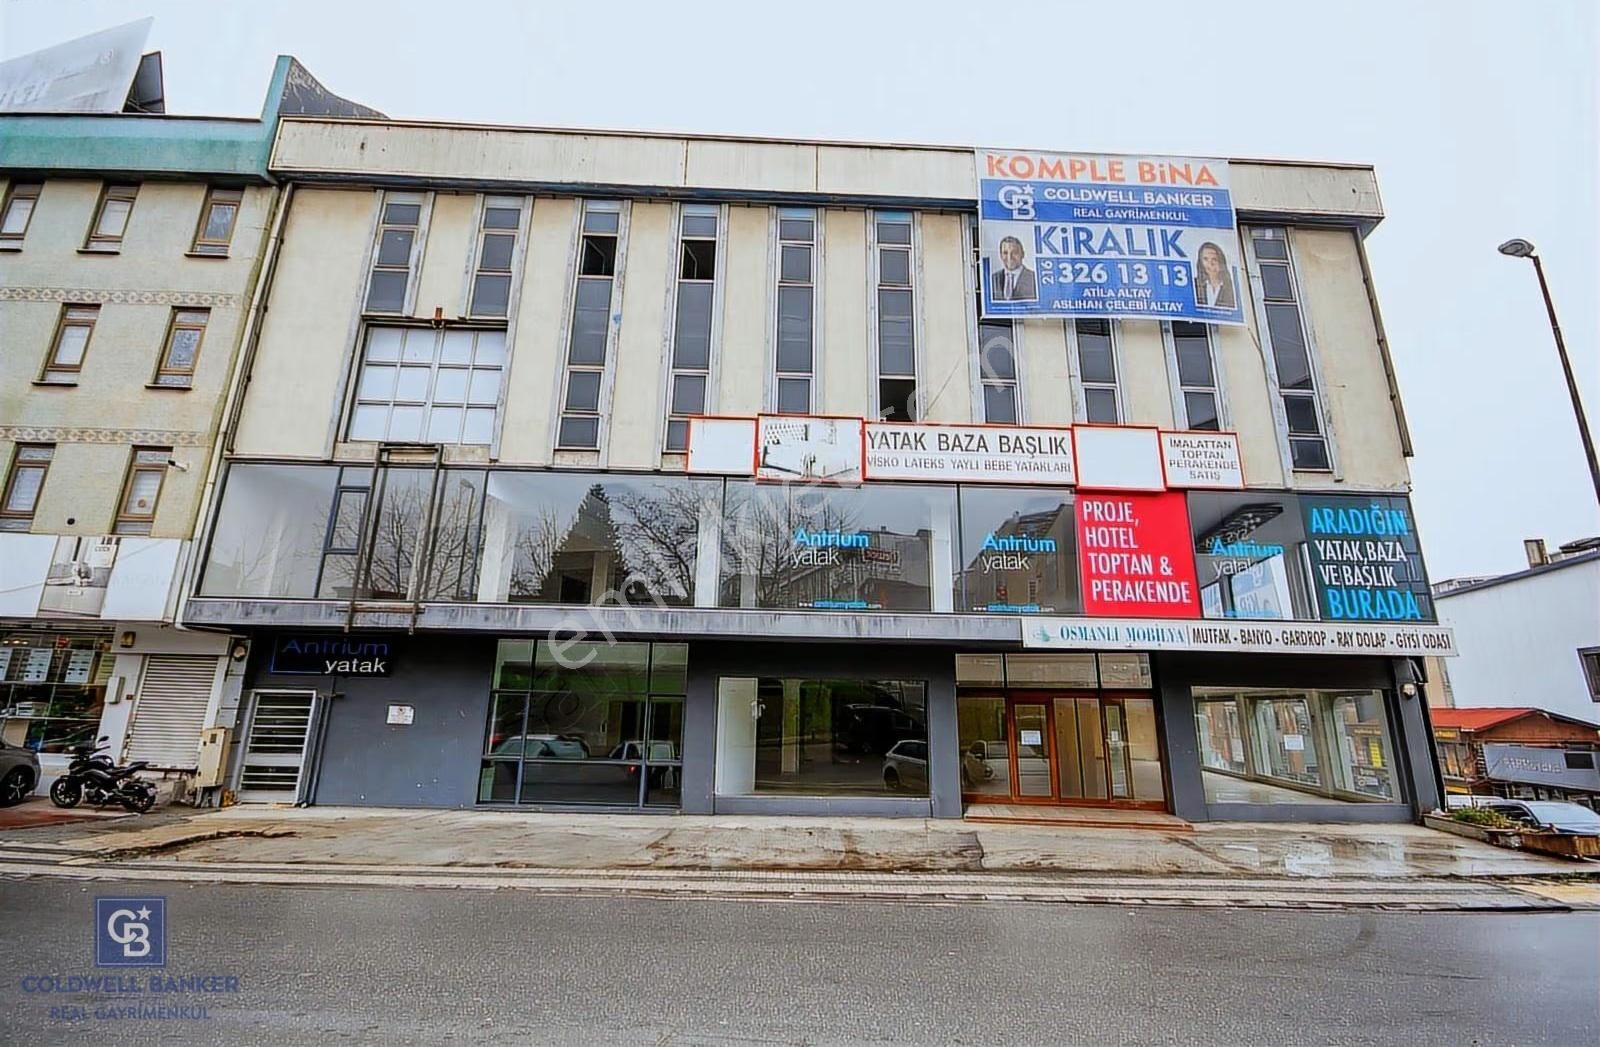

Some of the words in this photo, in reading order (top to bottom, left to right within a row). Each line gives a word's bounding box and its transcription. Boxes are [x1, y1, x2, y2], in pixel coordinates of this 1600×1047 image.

[986, 154, 1124, 182] KOMPLE
[1043, 187, 1140, 204] COLDWELL
[1143, 192, 1215, 207] BANKER
[1073, 208, 1103, 218] REAL
[1105, 207, 1190, 221] GAYRİMENKUL
[1058, 262, 1108, 284] 326
[1118, 263, 1149, 285] 13
[1158, 264, 1189, 287] 13
[1117, 287, 1153, 298] ALTAY
[1052, 299, 1103, 310] ASLIHAN
[1149, 301, 1184, 312] ALTAY
[867, 430, 927, 451] YATAK
[937, 432, 989, 453] BAZA
[999, 434, 1068, 458] BAŞLIK
[1180, 449, 1225, 460] TOPTAN
[867, 454, 899, 468] VİSKO
[905, 457, 945, 469] LATEKS
[950, 458, 980, 471] YAYLI
[984, 459, 1013, 472] BEBE
[1015, 460, 1071, 473] YATAKLARI
[1169, 459, 1238, 470] PERAKENDE
[1082, 501, 1140, 526] PROJE,
[1311, 503, 1409, 536] ARADIĞIN
[794, 525, 870, 548] Antrium
[982, 530, 1056, 552] Antrium
[1085, 526, 1139, 549] HOTEL
[790, 547, 840, 568] yatak
[982, 552, 1030, 574] yatak
[1088, 552, 1153, 575] TOPTAN
[1159, 555, 1174, 576] &
[1318, 564, 1341, 586] VE
[1342, 565, 1398, 590] BAŞLIK
[1091, 579, 1192, 604] PERAKENDE
[1327, 589, 1422, 620] BURADA
[282, 638, 389, 656] Antrium
[1060, 625, 1120, 642] OSMANLI
[1125, 624, 1185, 643] MOBİLYA
[1192, 627, 1232, 645] MUTFAK
[1240, 628, 1272, 645] BANYO
[1281, 630, 1327, 647] GARDROP
[1336, 631, 1354, 647] RAY
[1356, 632, 1387, 648] DOLAP
[1423, 634, 1451, 649] ODASI
[324, 657, 388, 675] yatak
